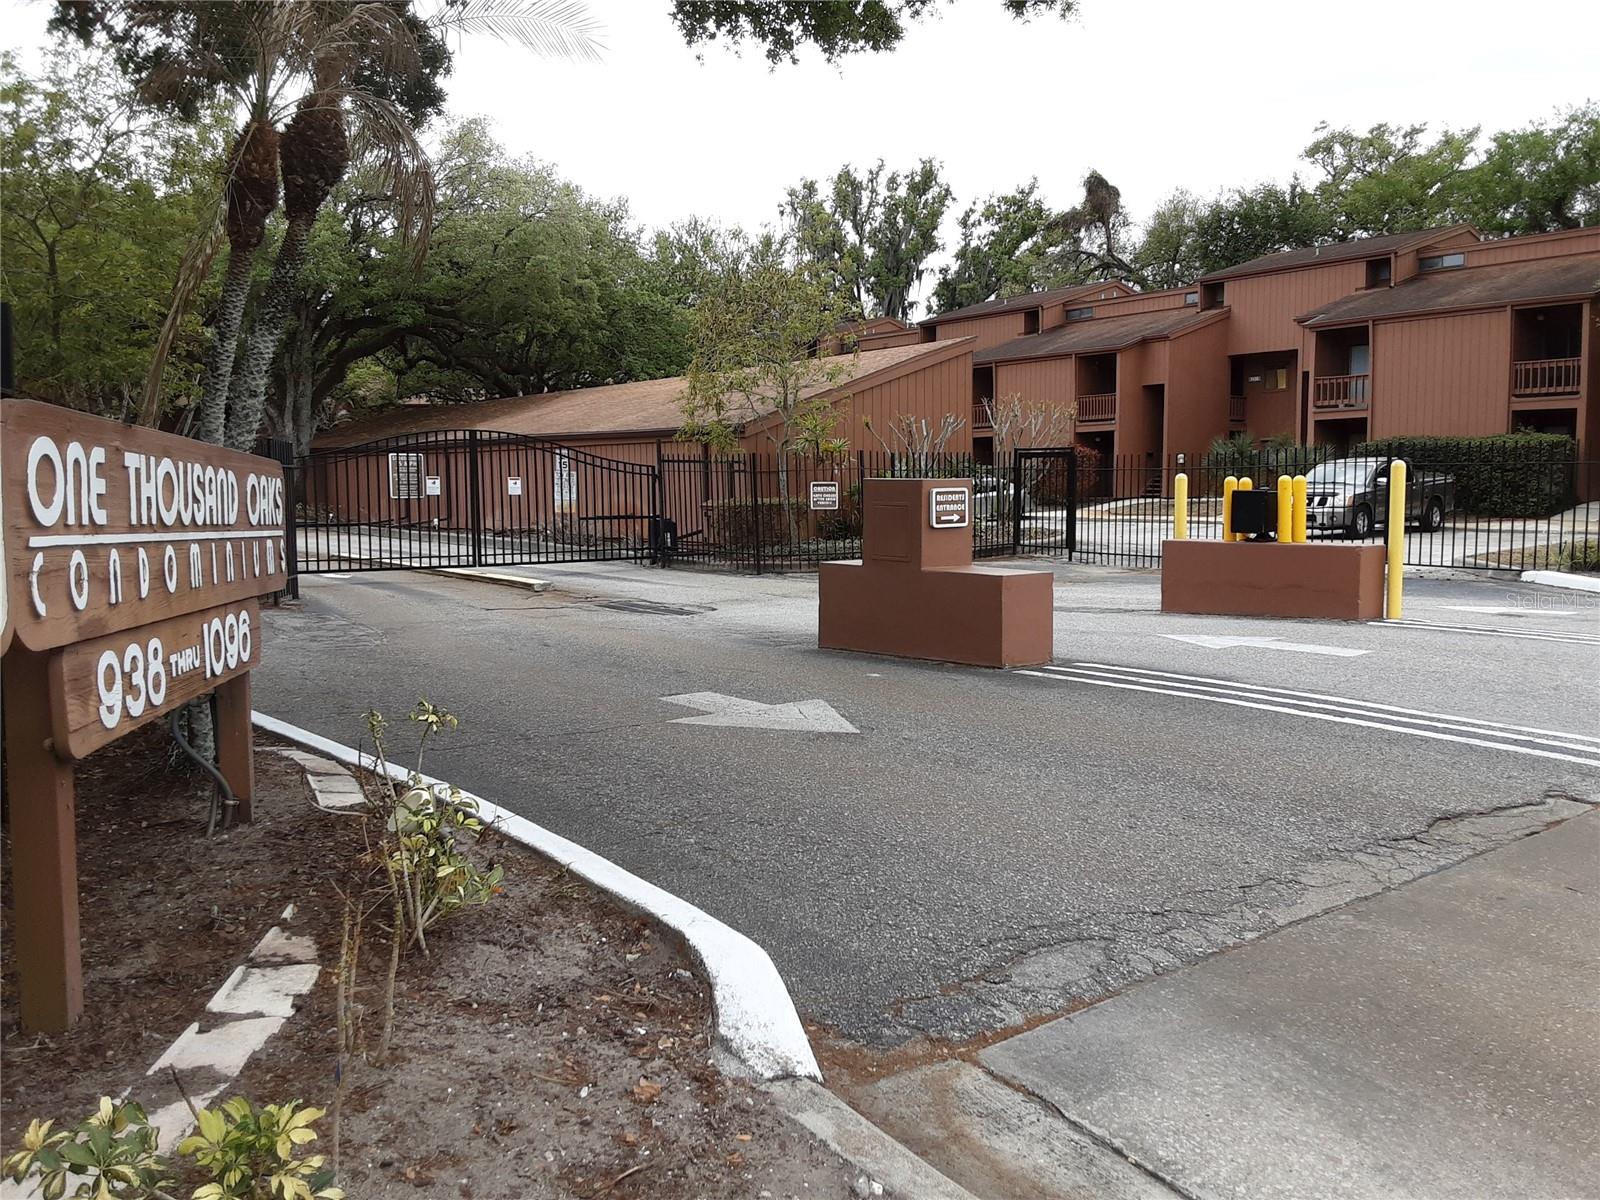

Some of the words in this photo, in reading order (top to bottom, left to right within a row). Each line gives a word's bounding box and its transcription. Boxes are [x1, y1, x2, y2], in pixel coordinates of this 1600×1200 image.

[27, 436, 107, 527] ONE
[124, 451, 239, 527] THOUSAND
[247, 473, 283, 527] OAKS
[936, 493, 965, 502] RESIDENTS
[936, 503, 965, 512] ENTRANCE
[30, 538, 286, 617] CONDOMINIUMS
[97, 637, 166, 729] 938
[169, 645, 200, 678] THRU
[203, 610, 251, 679] 1096
